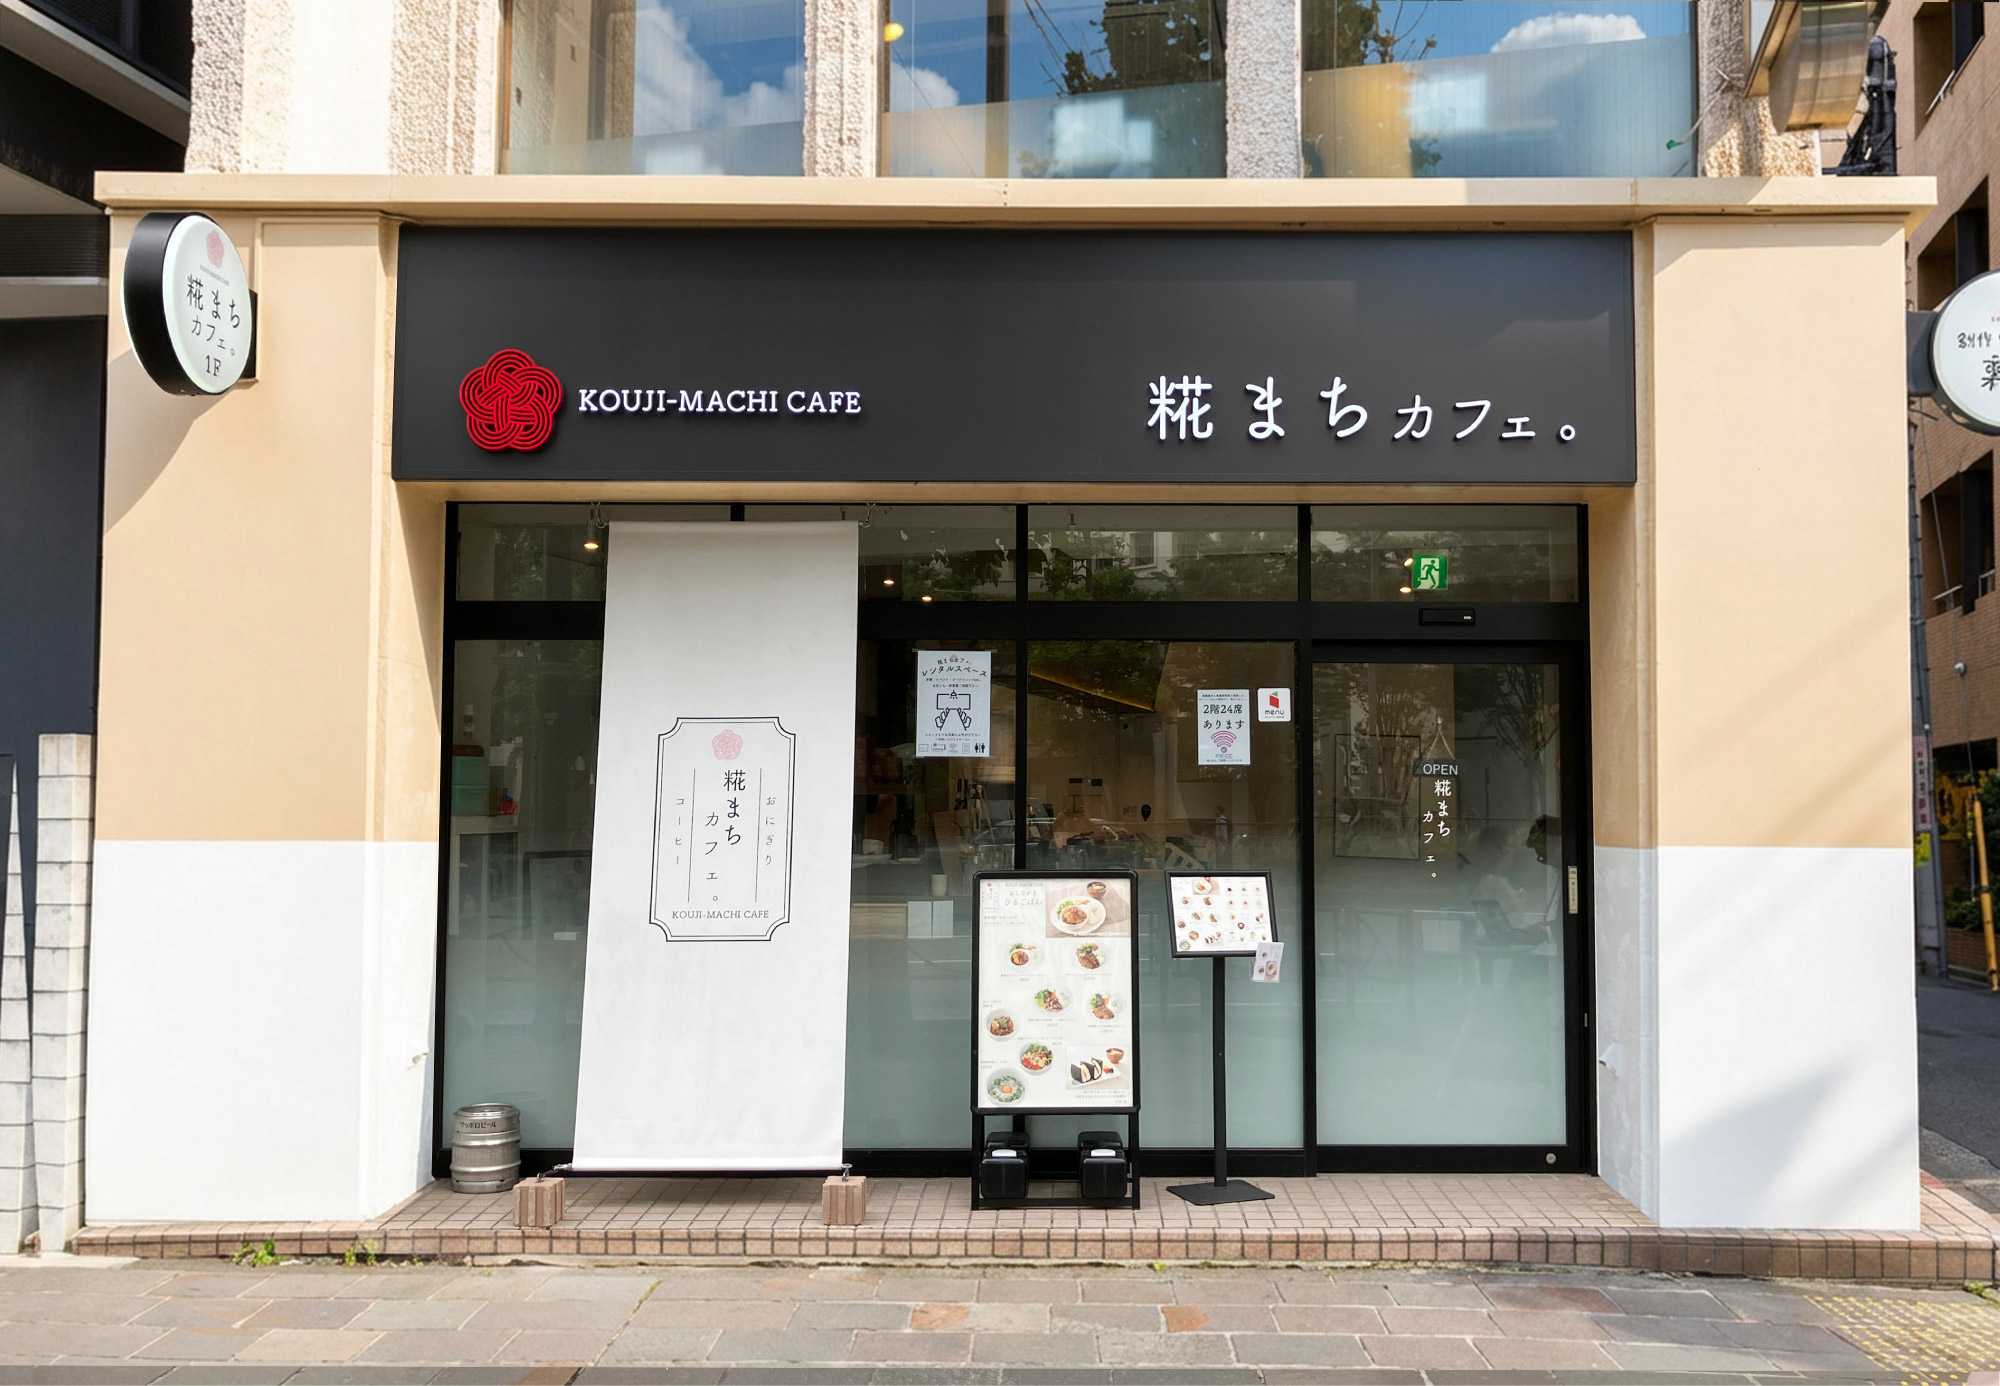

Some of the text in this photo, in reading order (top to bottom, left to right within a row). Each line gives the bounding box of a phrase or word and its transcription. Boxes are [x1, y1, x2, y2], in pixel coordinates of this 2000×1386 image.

[187, 274, 240, 328] 糀まち
[205, 354, 221, 377] 1F
[578, 388, 862, 414] KOUJI-MACHI CAFE
[922, 665, 987, 677] レンタルスペース
[1203, 704, 1243, 714] 2階24席
[1203, 719, 1245, 730] あります
[1423, 763, 1458, 775] OPEN
[723, 769, 746, 846] 糀まち
[1434, 779, 1452, 837] 糀まち
[675, 797, 685, 866] コーヒー
[765, 796, 776, 866] おにぎり
[671, 910, 769, 919] KOUJI-MACHI CAFE
